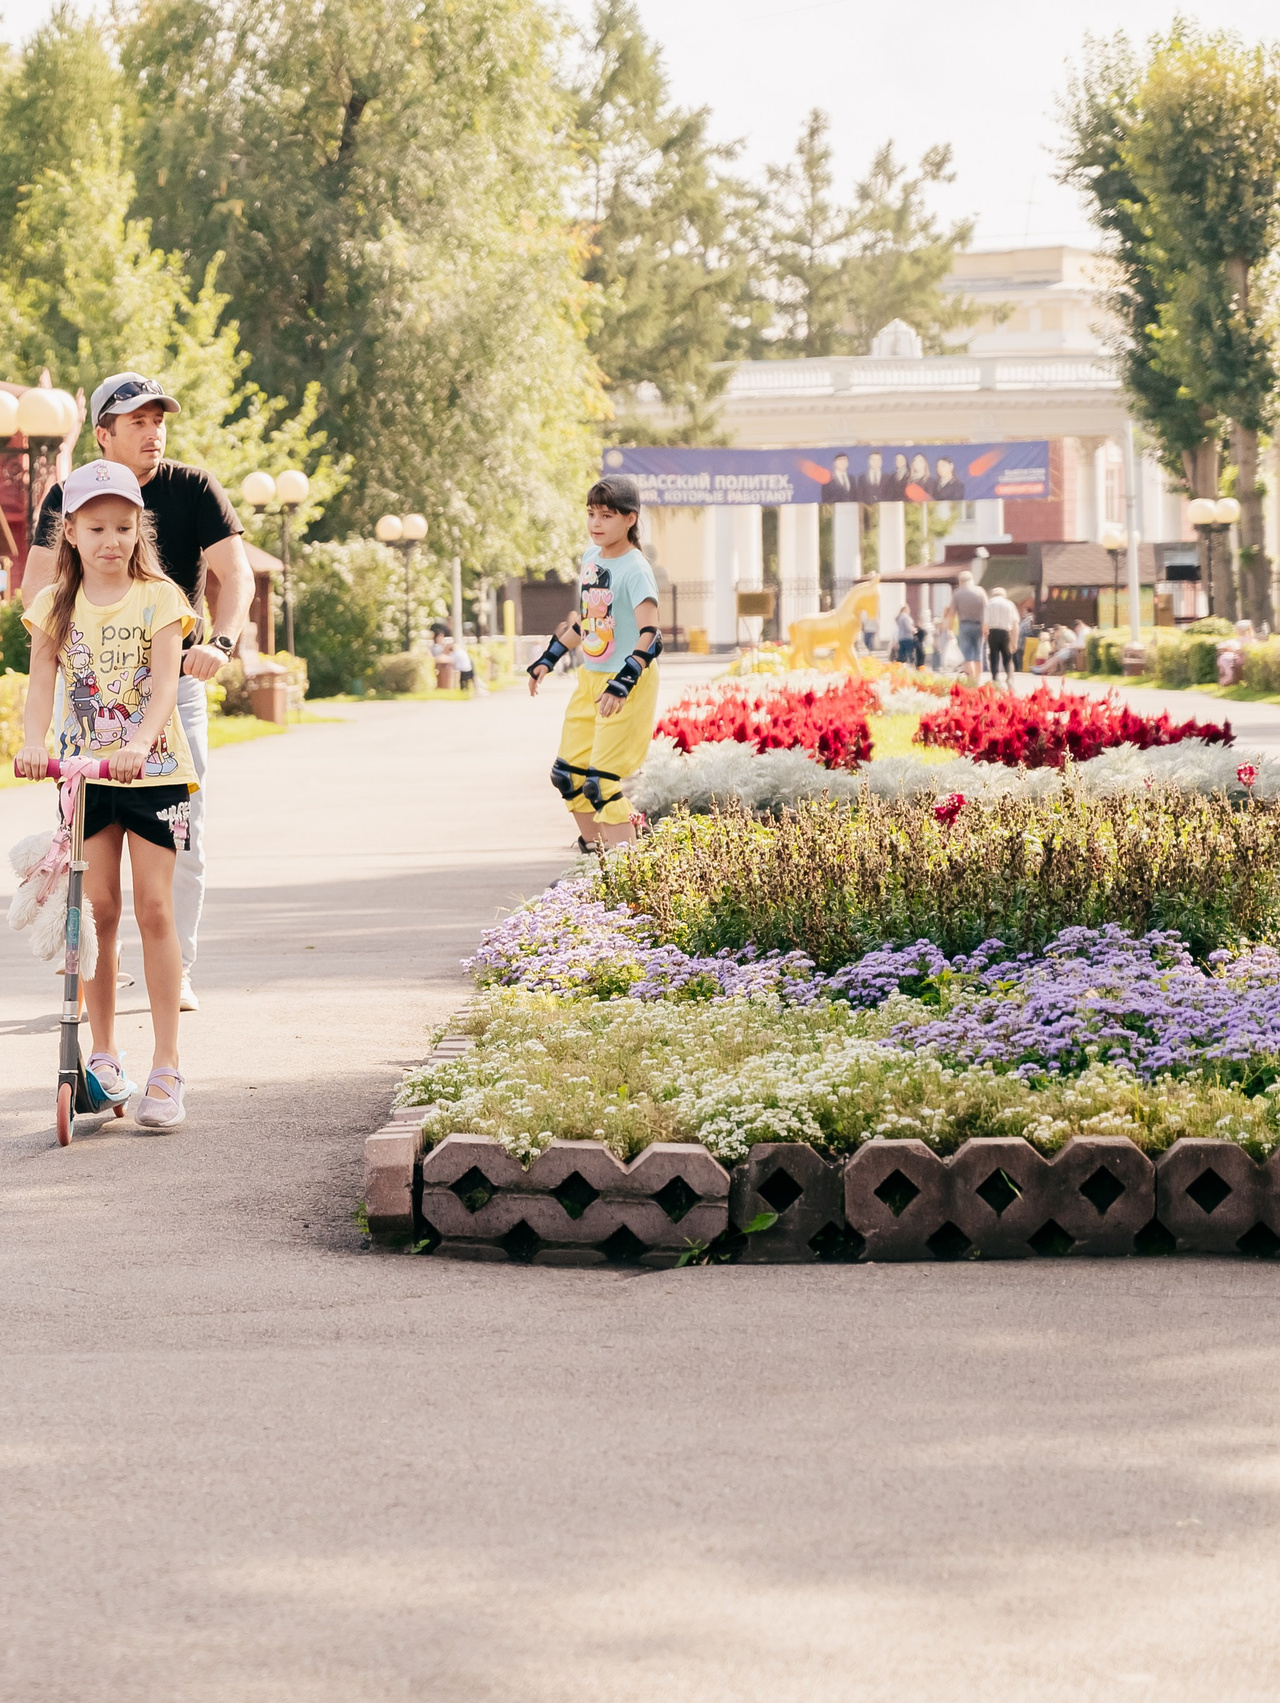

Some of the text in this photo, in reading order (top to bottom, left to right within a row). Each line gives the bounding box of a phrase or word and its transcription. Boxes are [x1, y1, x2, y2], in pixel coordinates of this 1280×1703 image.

[613, 472, 710, 490] БАССКИЙ
[664, 490, 725, 503] КОТОРЫЕ
[727, 489, 794, 503] РАБОТАЮТ
[101, 625, 152, 651] pony
[100, 644, 149, 673] girls
